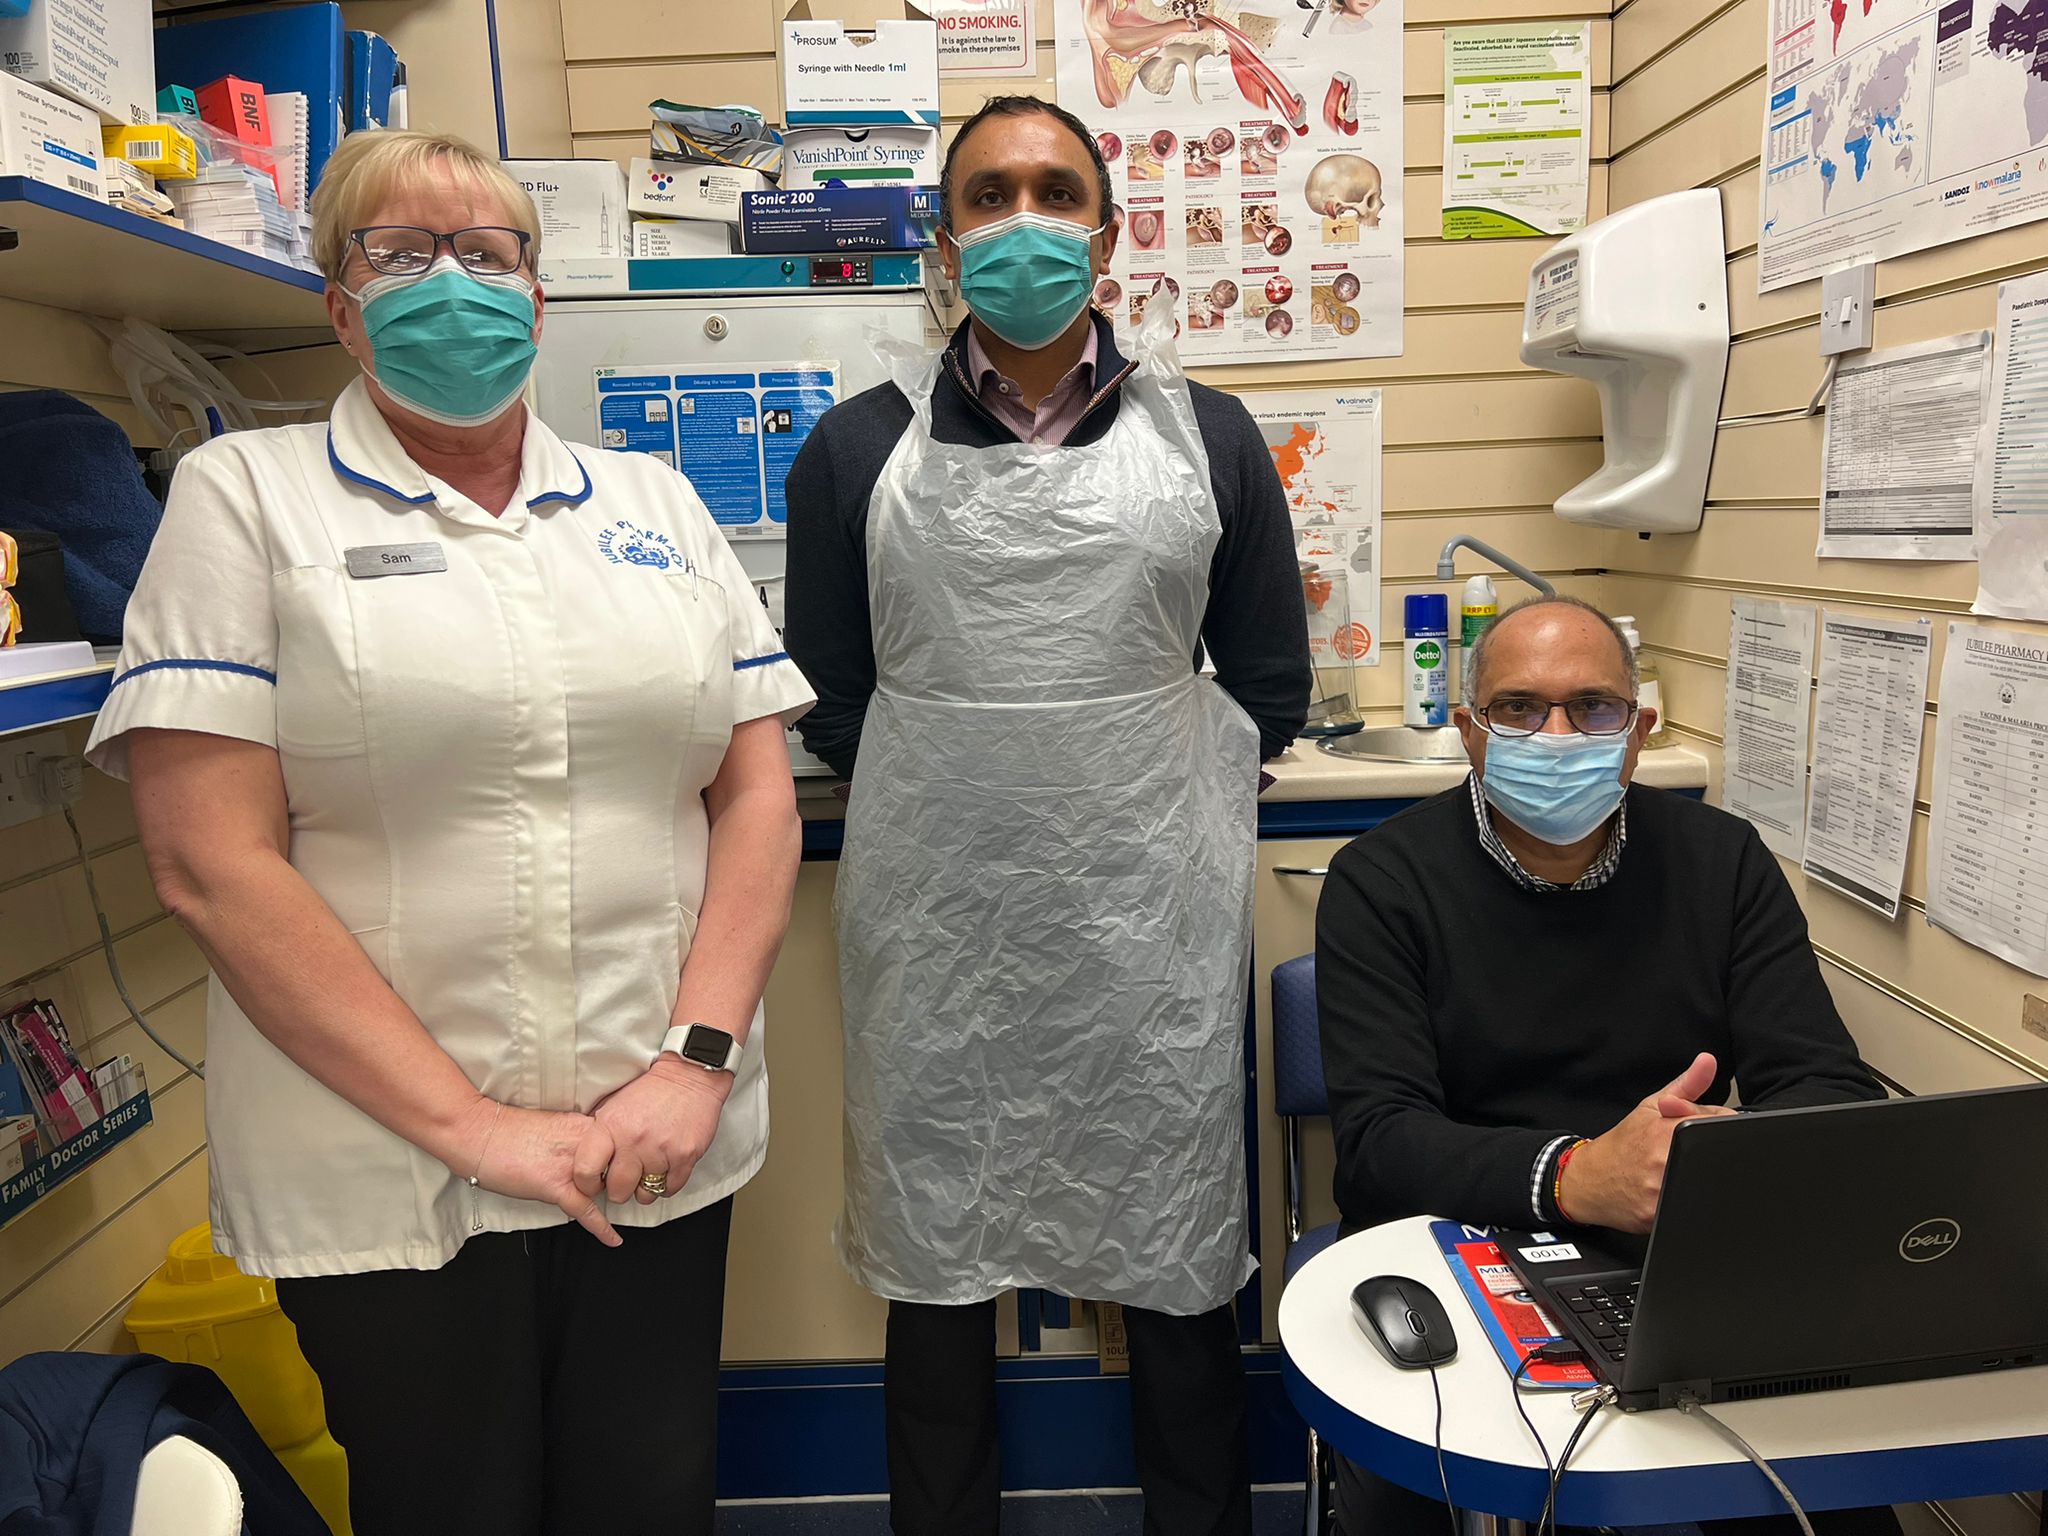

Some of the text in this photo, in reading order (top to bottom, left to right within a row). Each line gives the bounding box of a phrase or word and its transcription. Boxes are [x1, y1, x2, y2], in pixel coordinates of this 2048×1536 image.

[938, 15, 1021, 30] NO SMOKING.
[956, 36, 981, 45] against
[969, 45, 988, 53] these
[989, 45, 1020, 54] premises
[4, 53, 20, 65] 100
[798, 63, 906, 74] Syringe with Needle 1ml
[130, 104, 141, 119] 100
[240, 92, 260, 132] BNF
[874, 145, 925, 164] Syringe
[537, 182, 559, 192] Flu+
[1944, 185, 1971, 200] SANDOZ
[790, 192, 815, 204] 200
[914, 195, 927, 208] M
[2012, 301, 2033, 311] Paediatric
[597, 528, 623, 564] JUBILEE
[381, 552, 412, 565] Sam
[1415, 651, 1440, 660] Dettol
[1967, 638, 2044, 661] JUBILEE PHARMACY
[1, 1164, 46, 1203] FAMILY
[51, 1129, 99, 1170] DOCTOR
[103, 1103, 138, 1135] SERIES
[1907, 1233, 1952, 1248] DELL
[1531, 1247, 1571, 1258] L100
